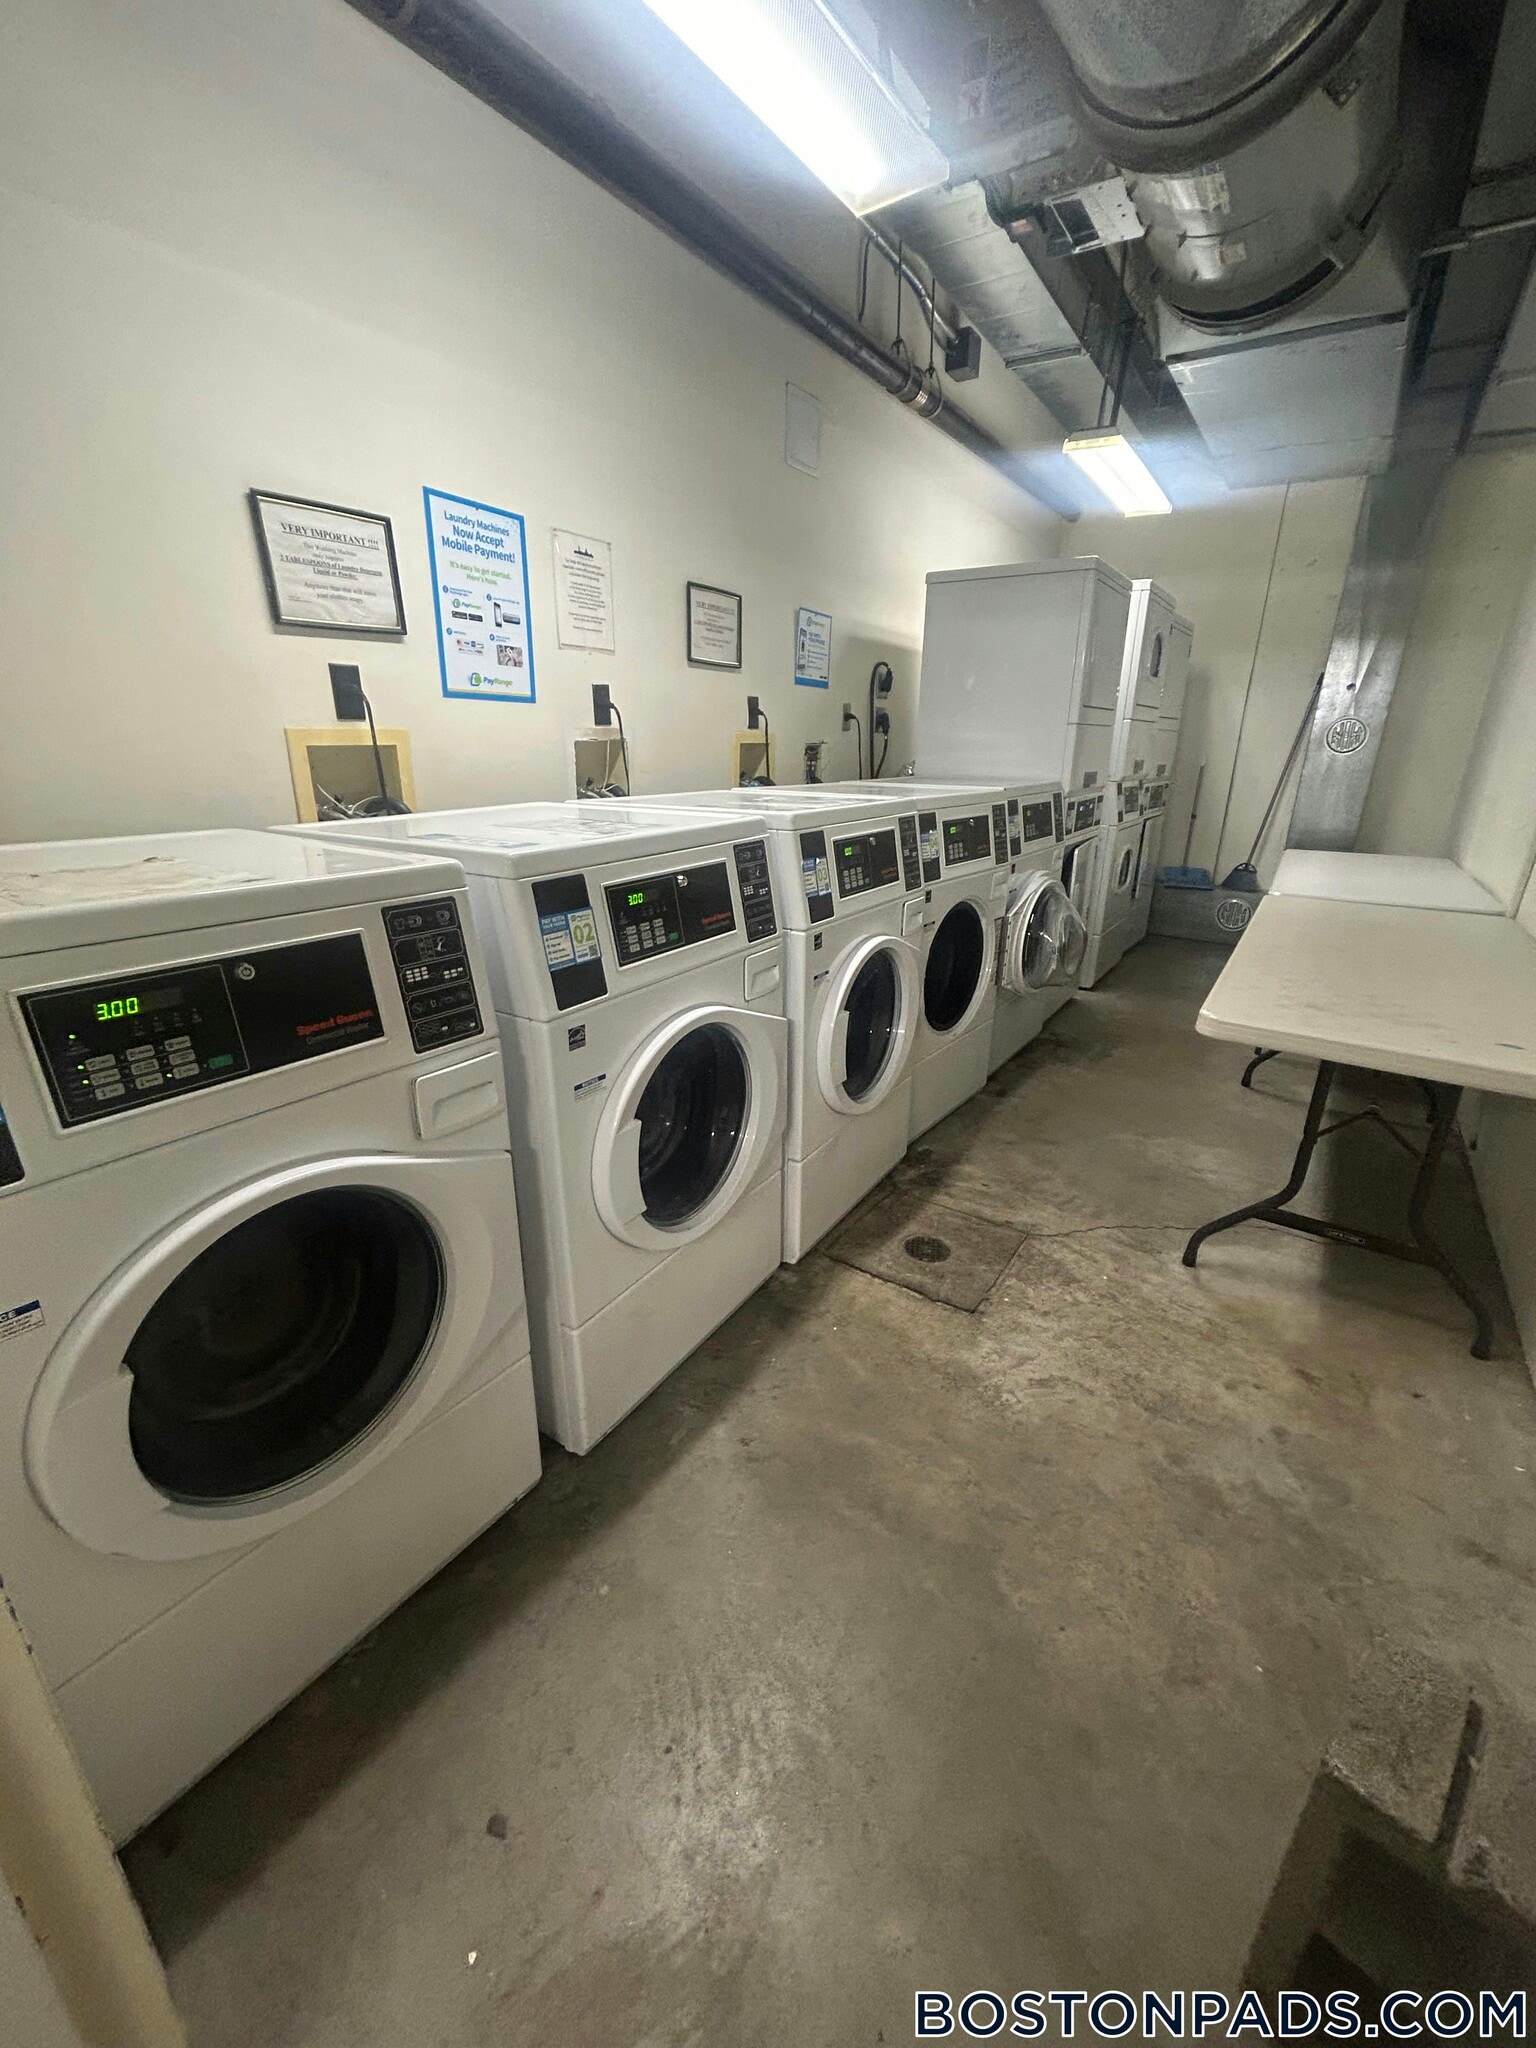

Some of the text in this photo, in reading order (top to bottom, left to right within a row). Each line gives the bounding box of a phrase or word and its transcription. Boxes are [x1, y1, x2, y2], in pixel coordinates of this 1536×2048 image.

[280, 522, 308, 535] VERY
[310, 528, 366, 547] IMPORTANT
[443, 510, 509, 536] Laundry Machines
[441, 535, 516, 563] Mobile Payment!
[453, 525, 505, 549] Now Accept
[285, 555, 331, 568] TABLESPOONS
[460, 564, 473, 573] easy
[483, 676, 514, 688] PayRange
[627, 893, 644, 906] 3.00
[573, 922, 595, 945] 02
[96, 997, 139, 1021] 3.00
[295, 1008, 374, 1036] Speed Queen
